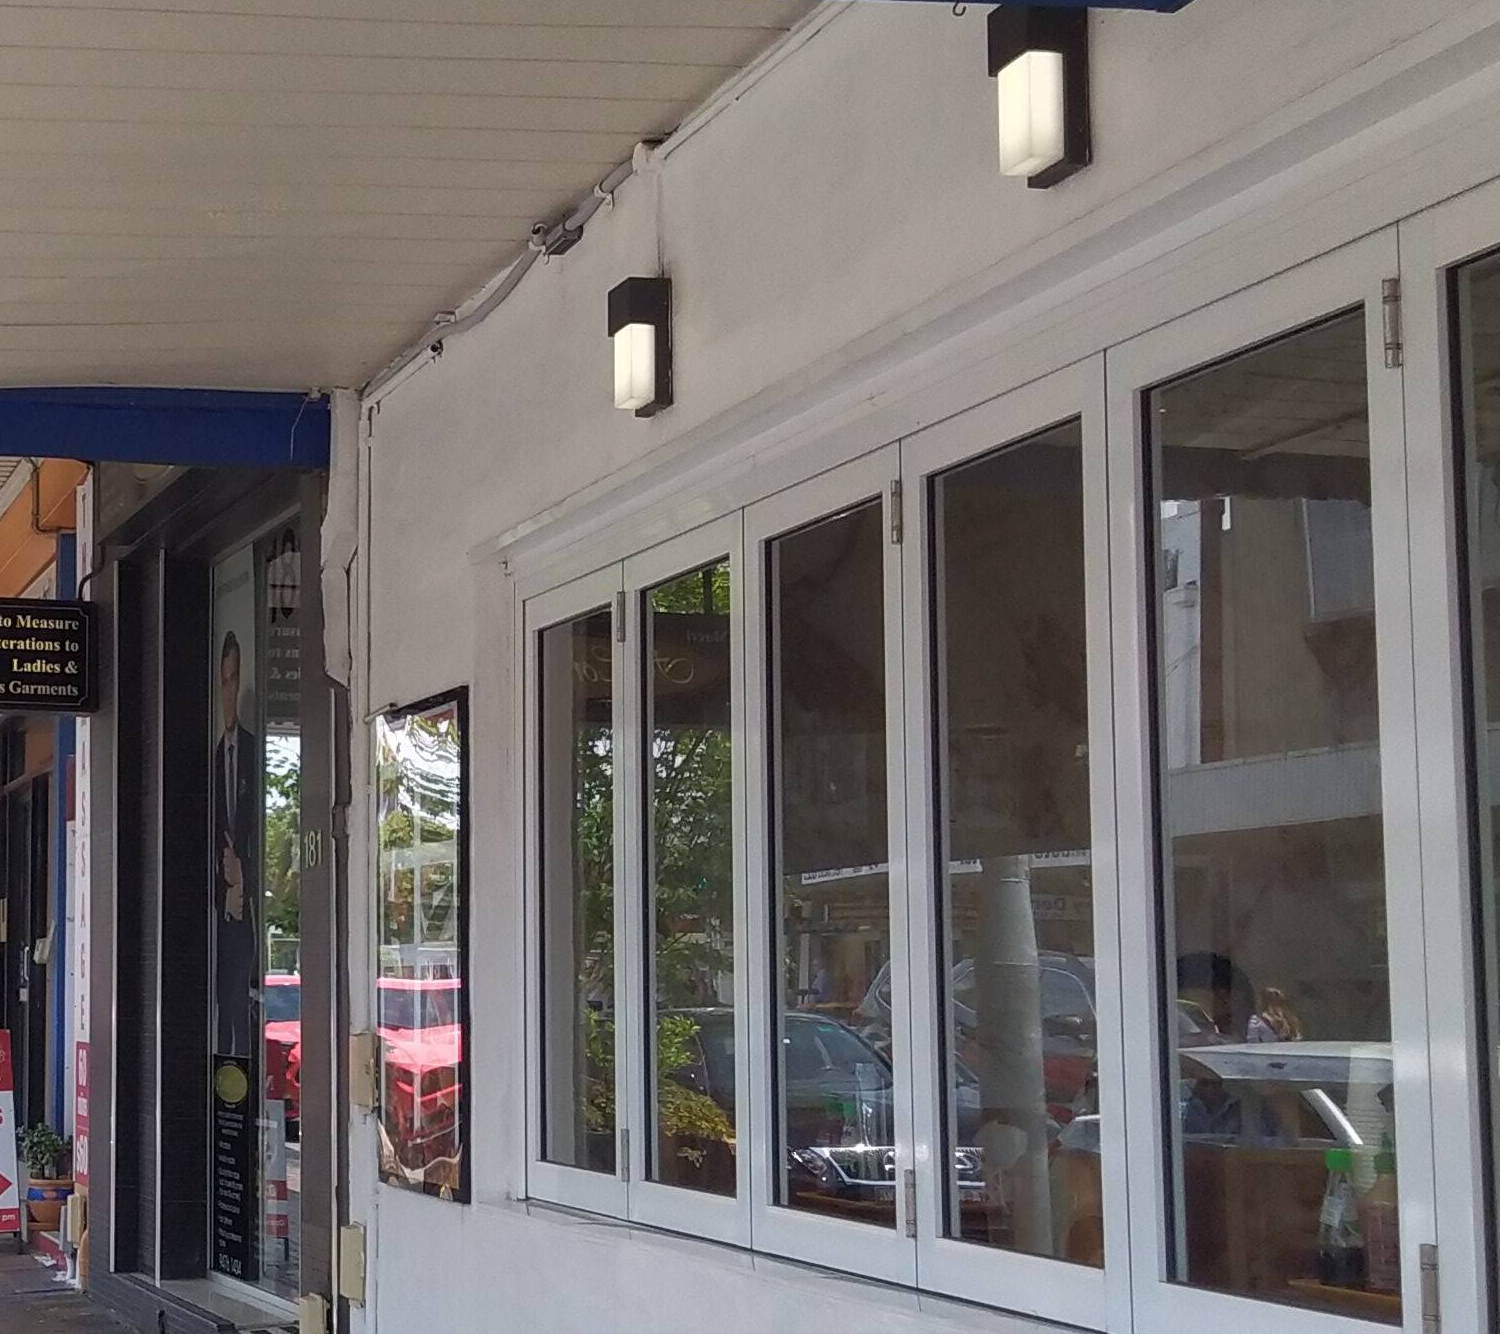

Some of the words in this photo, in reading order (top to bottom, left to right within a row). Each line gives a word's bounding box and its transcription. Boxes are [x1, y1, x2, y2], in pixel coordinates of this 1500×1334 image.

[15, 614, 80, 631] Measure
[65, 639, 79, 653] to
[12, 658, 61, 674] Ladies
[64, 660, 79, 674] &
[8, 680, 80, 697] Garments
[303, 828, 322, 868] 181
